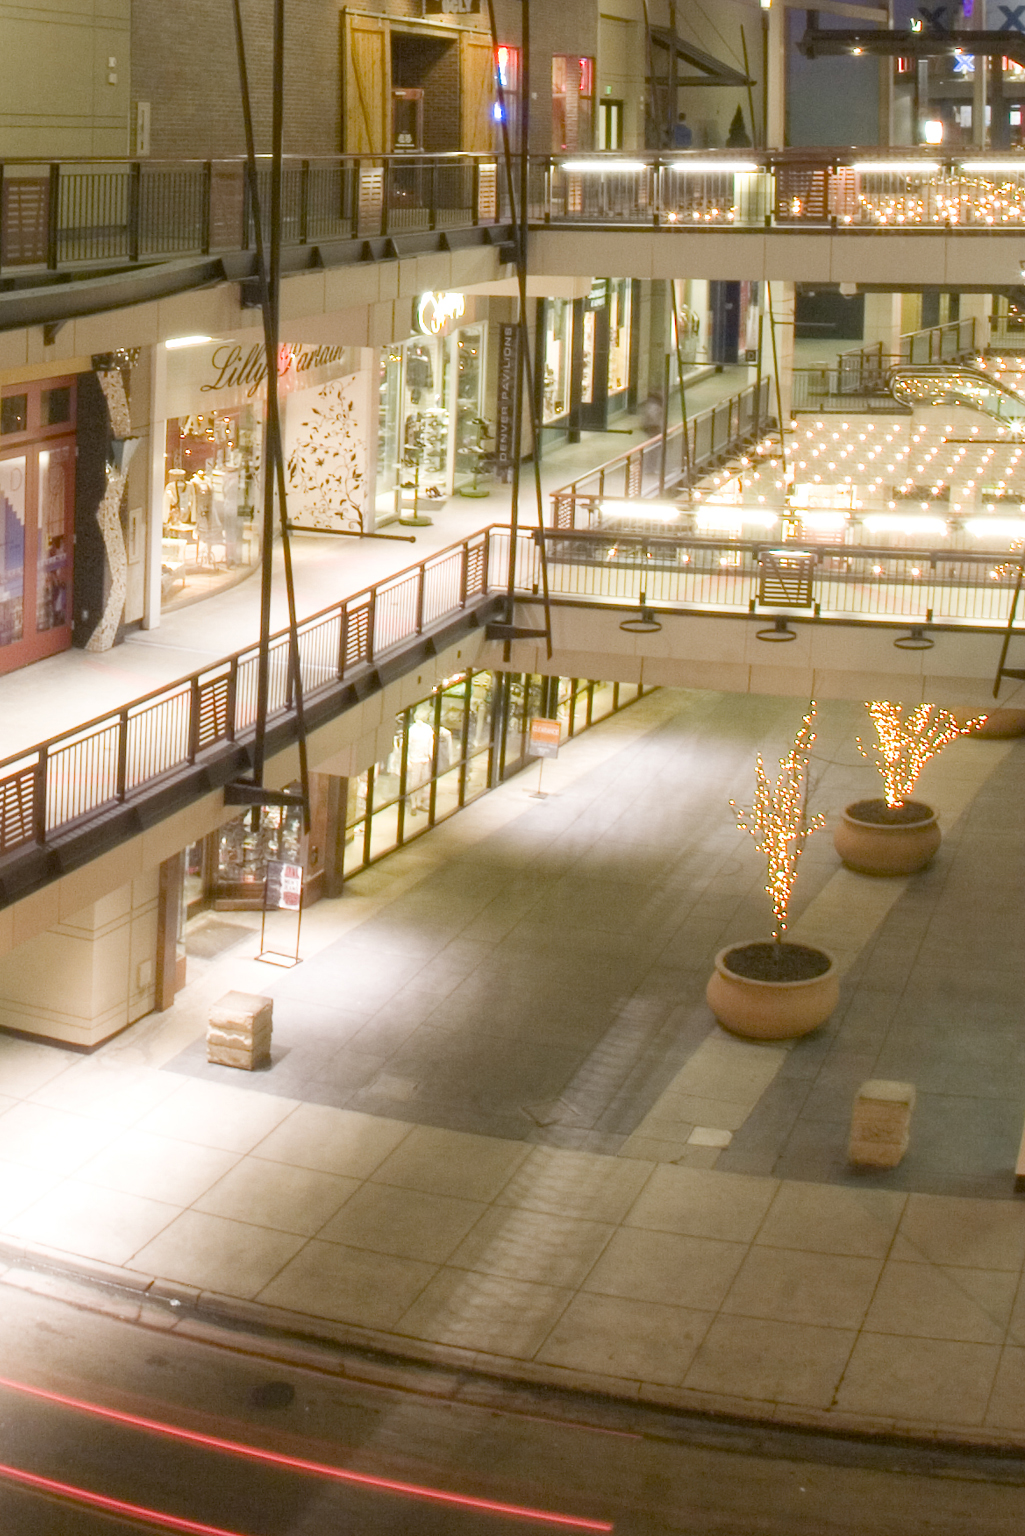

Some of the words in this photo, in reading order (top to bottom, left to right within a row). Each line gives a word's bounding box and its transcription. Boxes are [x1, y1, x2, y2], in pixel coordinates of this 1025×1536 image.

[199, 342, 269, 399] Lilly
[501, 326, 513, 400] PAVILIONS
[499, 405, 509, 462] DENVER
